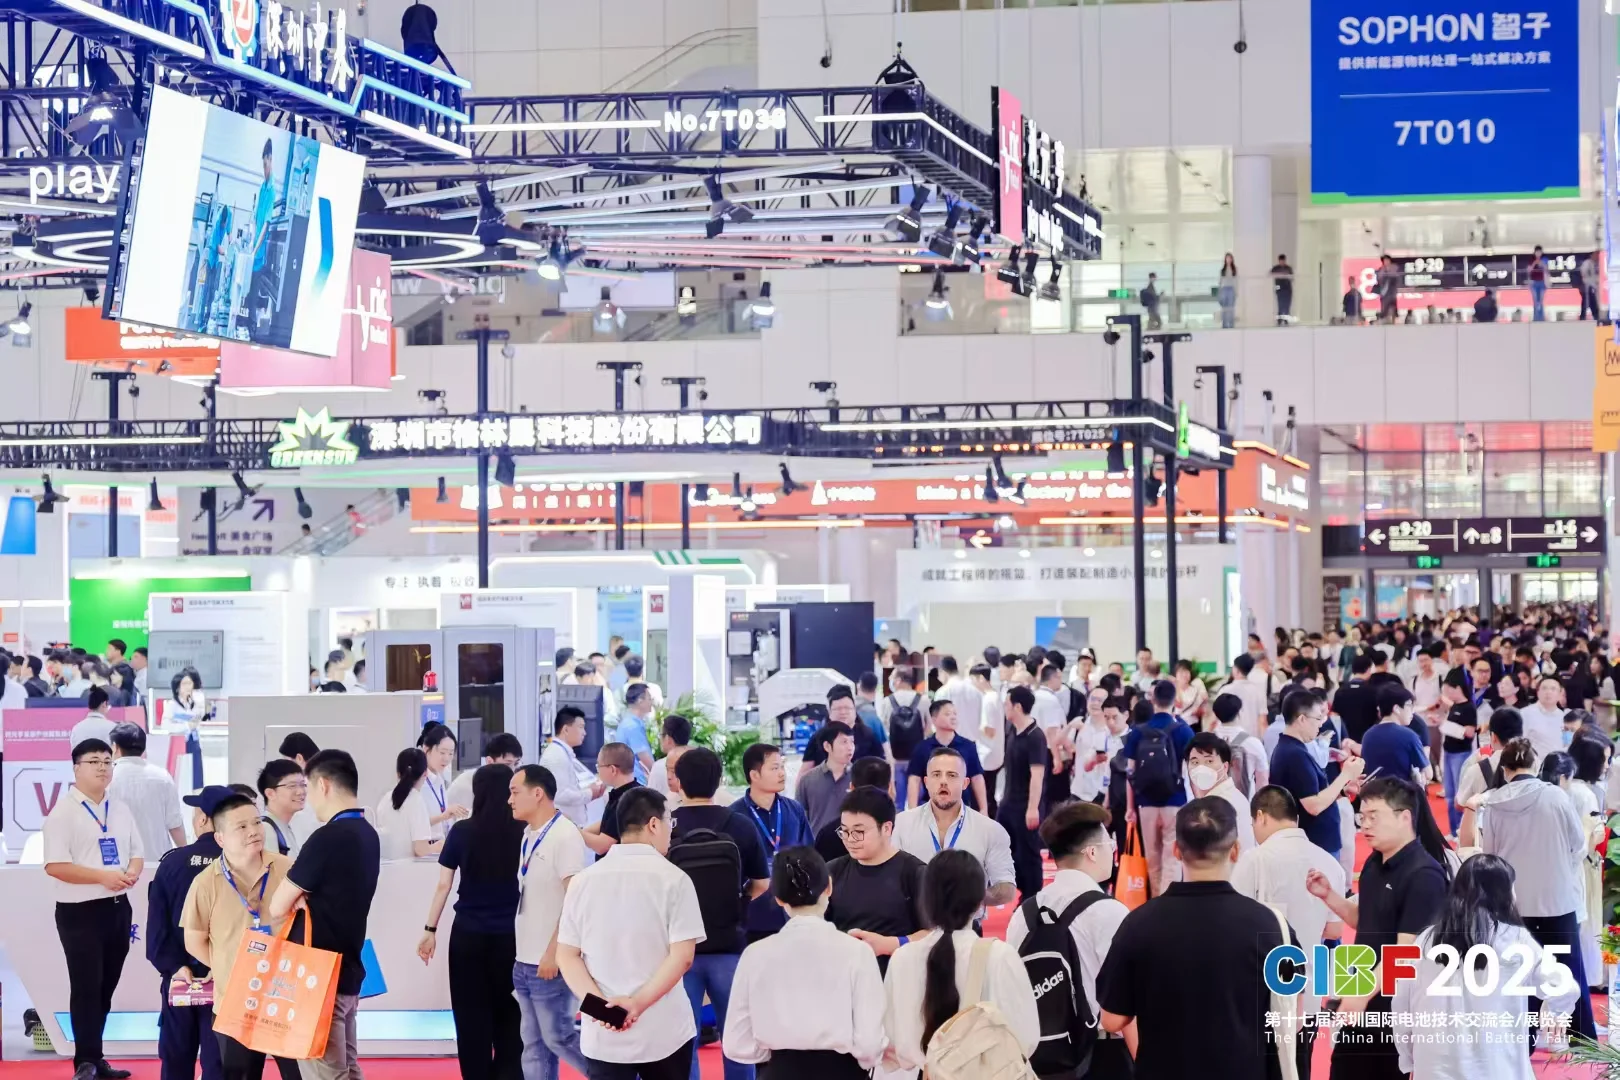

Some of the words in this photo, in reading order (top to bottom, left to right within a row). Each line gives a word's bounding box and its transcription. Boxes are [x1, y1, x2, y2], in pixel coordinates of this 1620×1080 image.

[1338, 13, 1484, 45] SOPHON
[1492, 12, 1551, 41] 智子
[1339, 51, 1551, 70] 提供新能源物料处理一站式解决方案
[1393, 118, 1496, 146] 7T010
[29, 165, 120, 204] play
[271, 450, 357, 467] GREENSUN
[190, 855, 202, 866] 保
[1033, 970, 1064, 1000] didas
